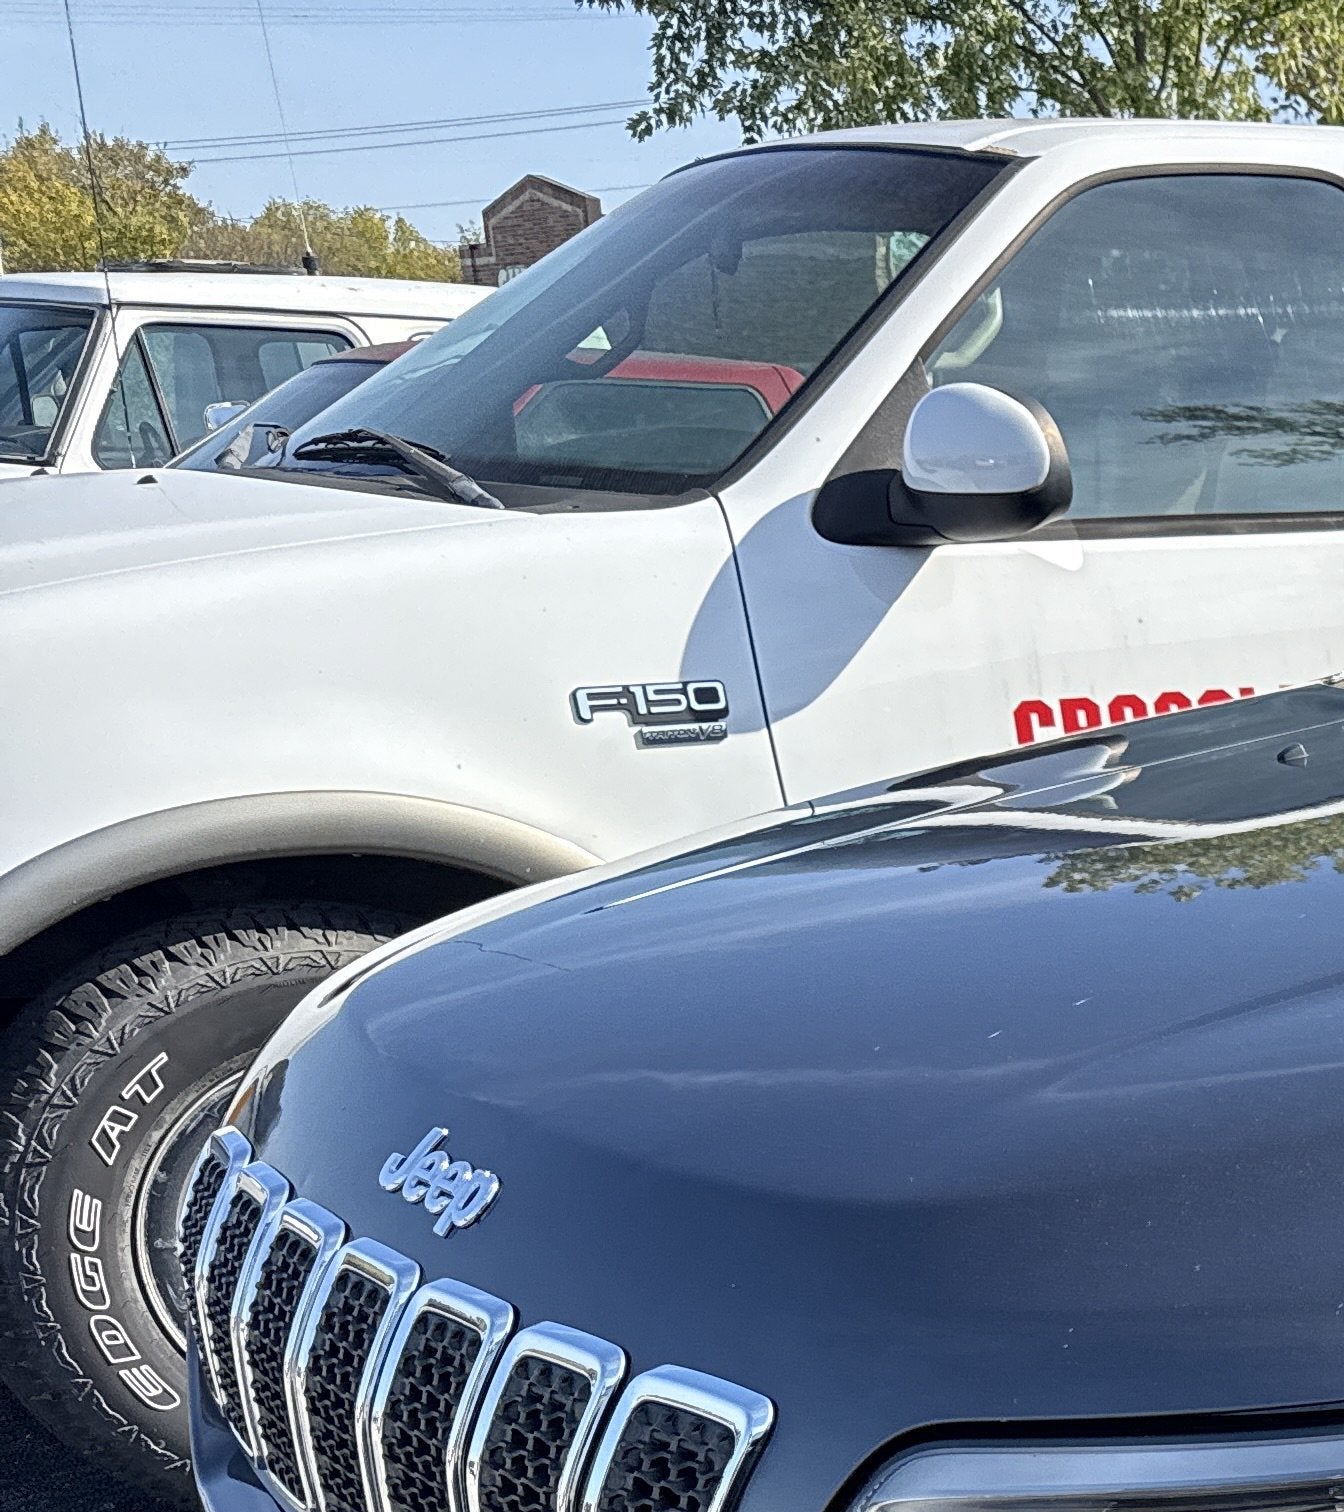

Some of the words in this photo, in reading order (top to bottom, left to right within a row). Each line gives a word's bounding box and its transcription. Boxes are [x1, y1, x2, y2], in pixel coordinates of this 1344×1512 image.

[90, 1051, 169, 1166] AT
[379, 1127, 499, 1236] Jeep
[69, 1188, 182, 1411] EDGE
